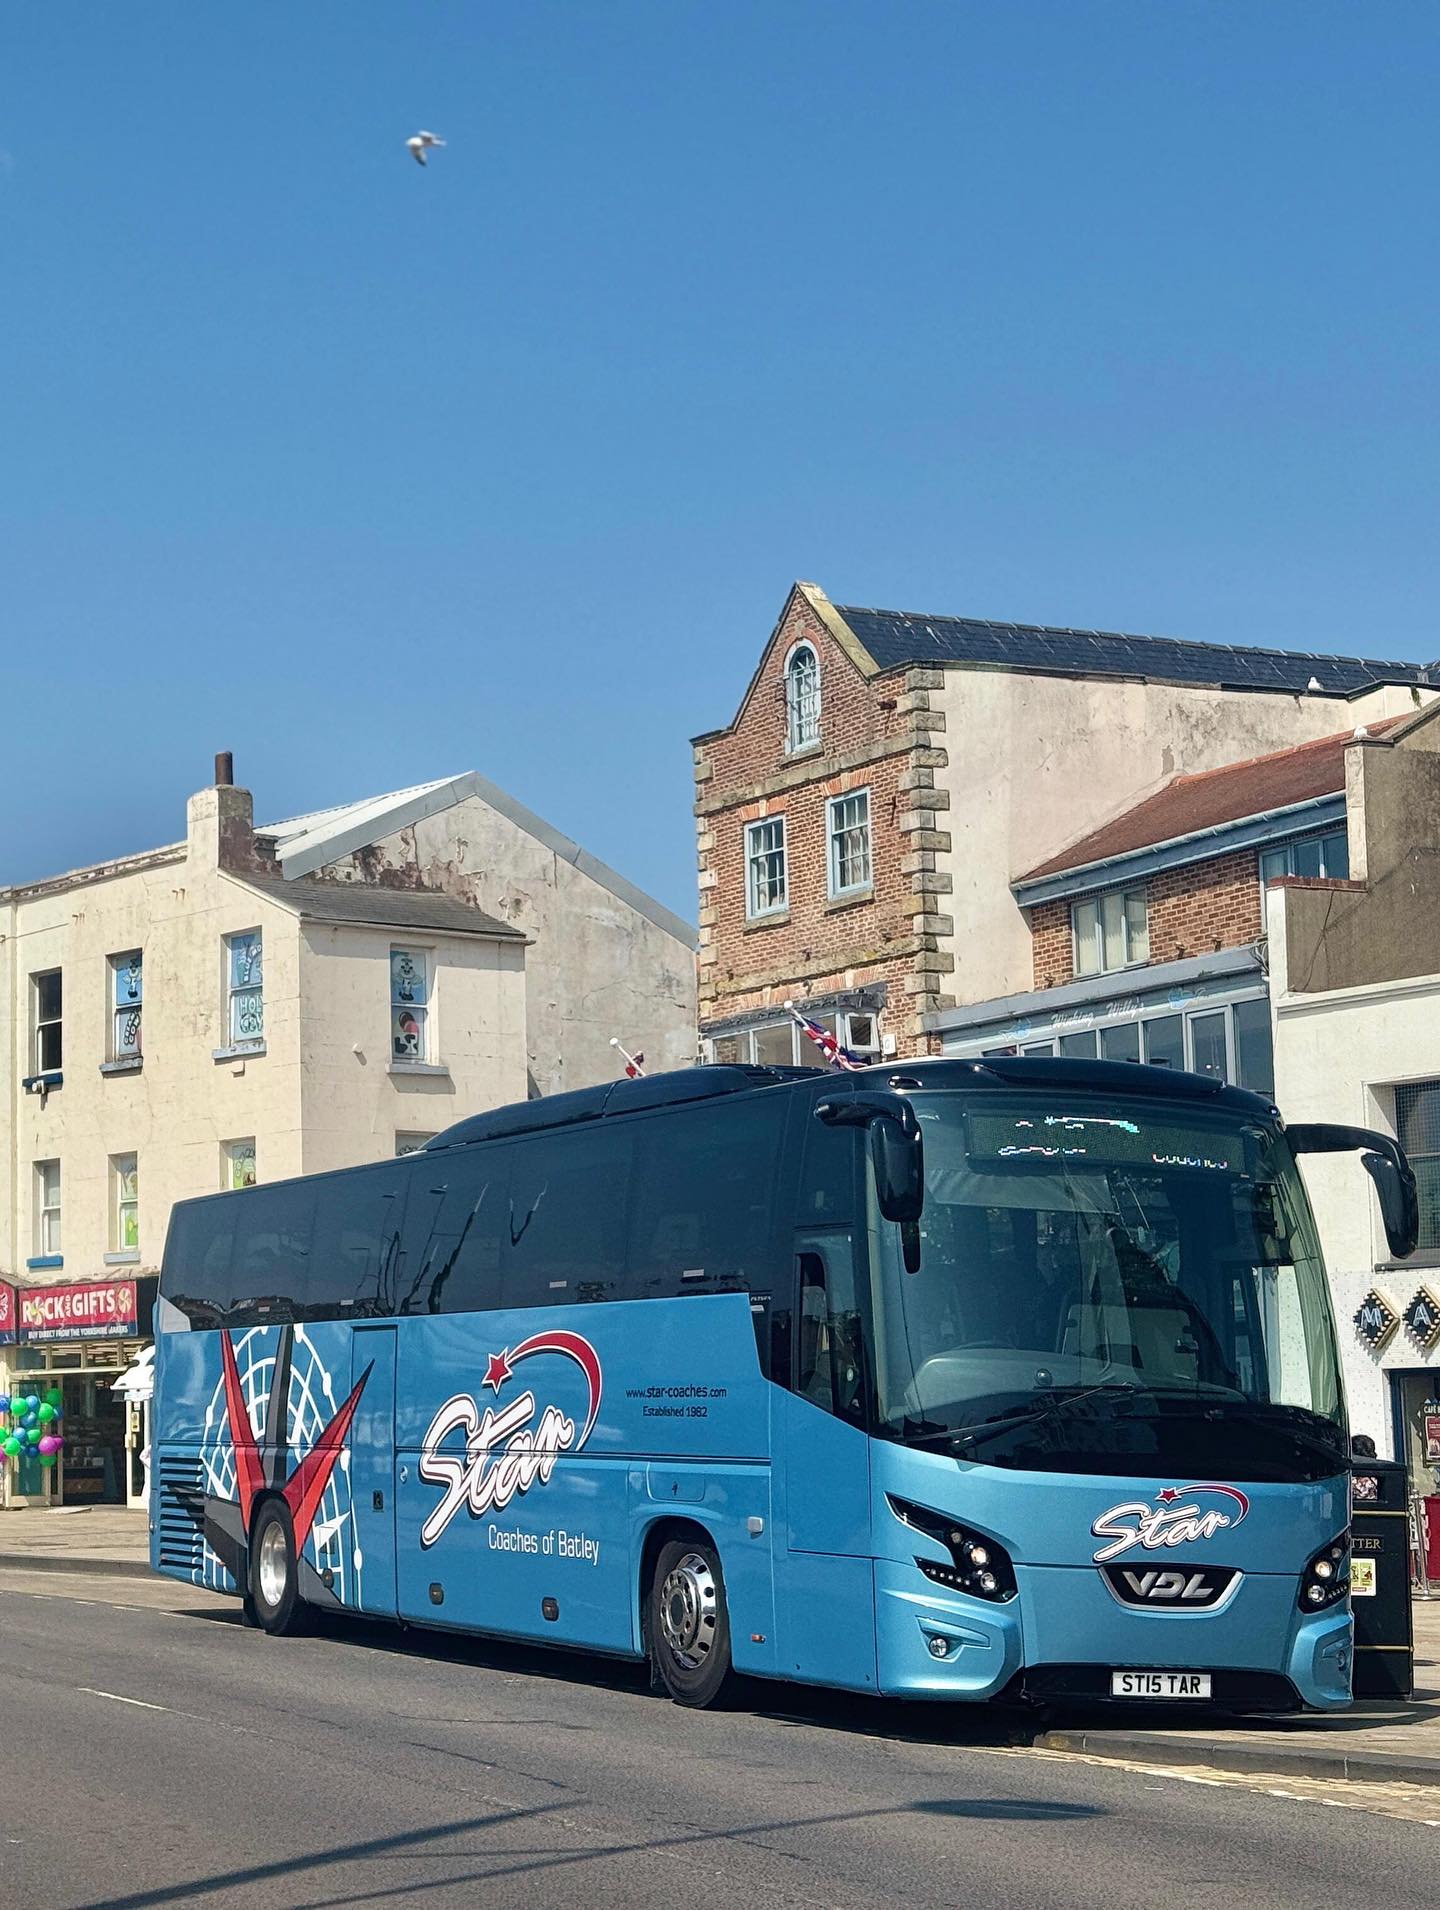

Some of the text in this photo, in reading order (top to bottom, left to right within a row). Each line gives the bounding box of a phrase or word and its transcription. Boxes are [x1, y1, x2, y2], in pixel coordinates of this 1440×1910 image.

[1050, 997, 1145, 1028] Winking Willy's
[72, 1289, 116, 1317] GIFTS
[70, 1327, 80, 1336] THE
[626, 1384, 727, 1398] www.star-coaches.com
[643, 1405, 685, 1417] Established
[419, 1390, 574, 1549] Star
[488, 1524, 600, 1566] Coaches of Batley
[1093, 1500, 1231, 1563] Star
[1122, 1572, 1214, 1598] VDL
[1122, 1676, 1201, 1694] ST15 TAR
